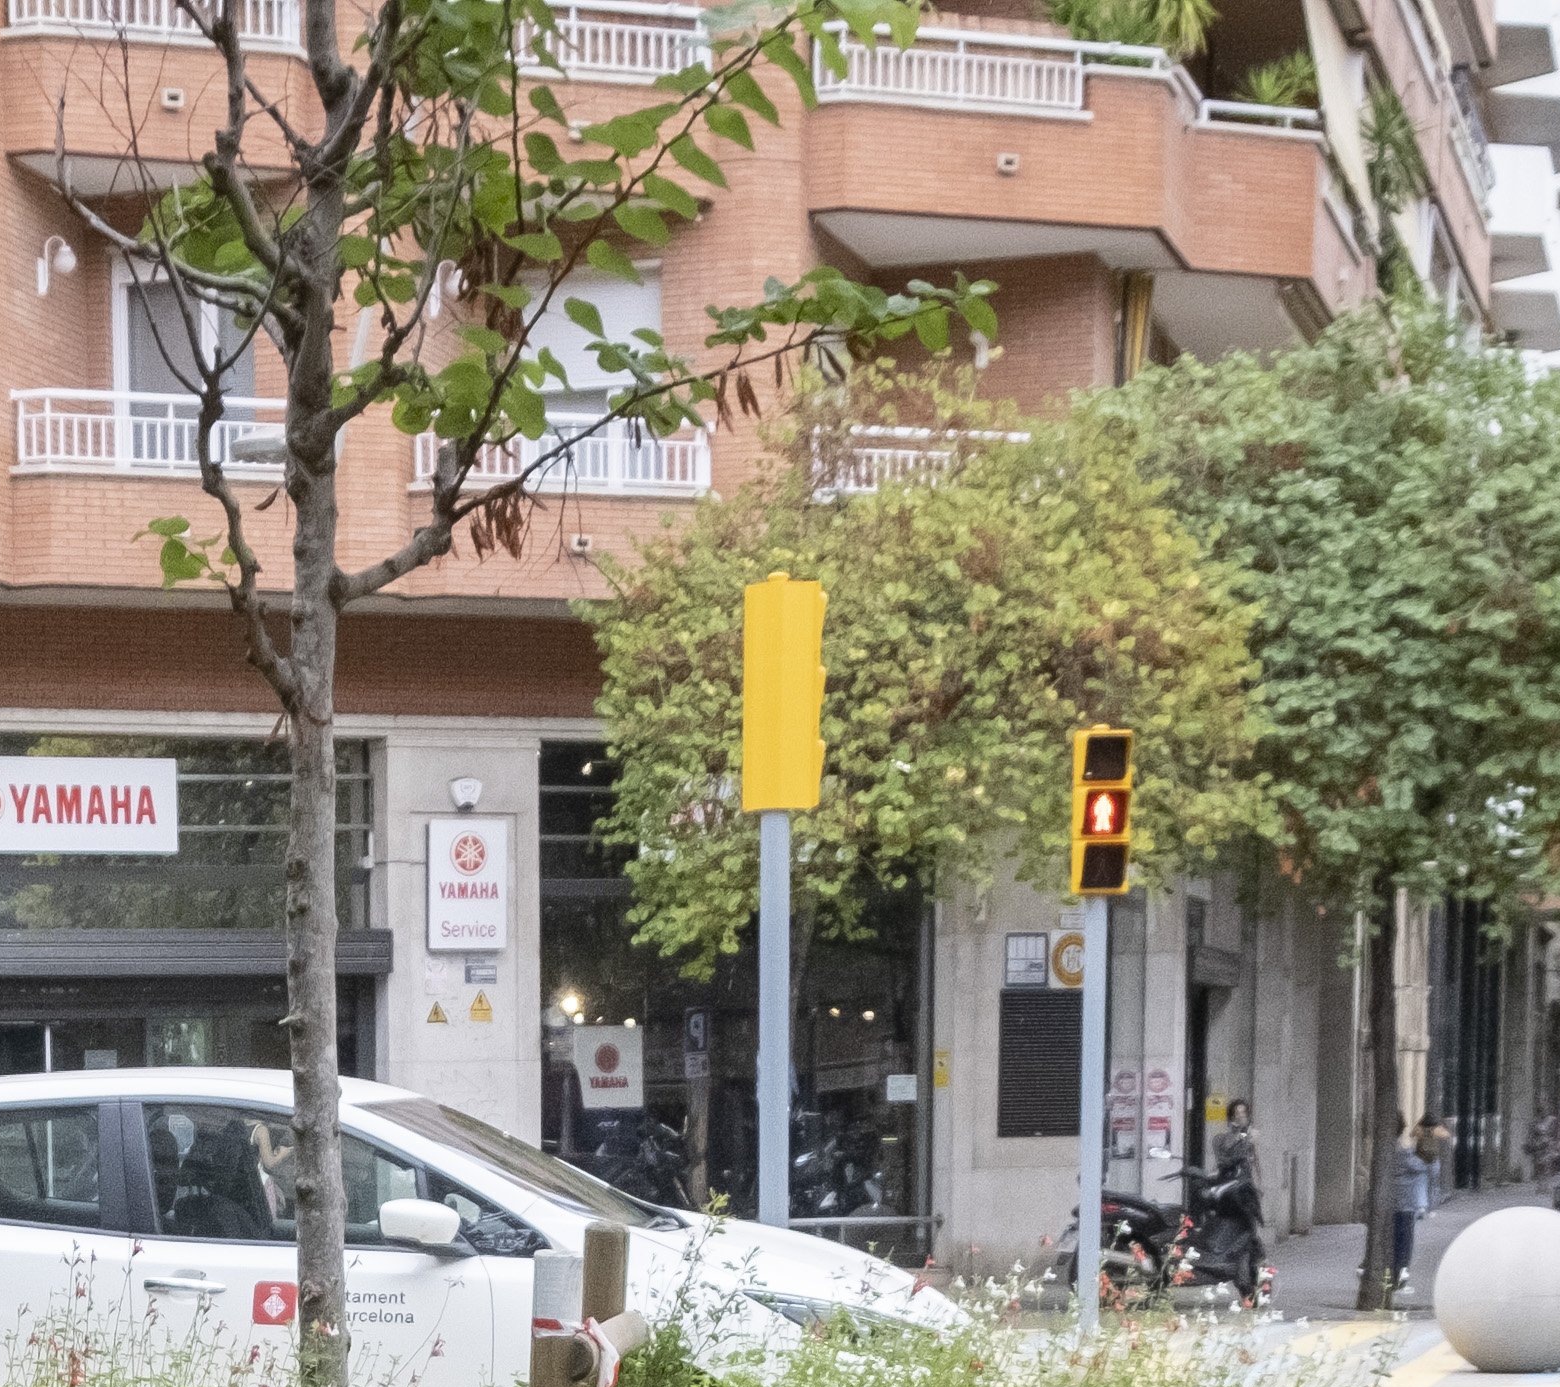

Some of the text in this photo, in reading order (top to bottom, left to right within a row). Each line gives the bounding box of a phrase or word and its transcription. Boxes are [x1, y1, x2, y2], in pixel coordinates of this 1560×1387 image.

[9, 783, 156, 825] YAMAHA
[439, 881, 499, 899] YAMAHA
[441, 920, 497, 938] Service
[589, 1076, 629, 1089] YAMAHA
[344, 1290, 406, 1304] tament
[345, 1308, 415, 1324] arcelona
